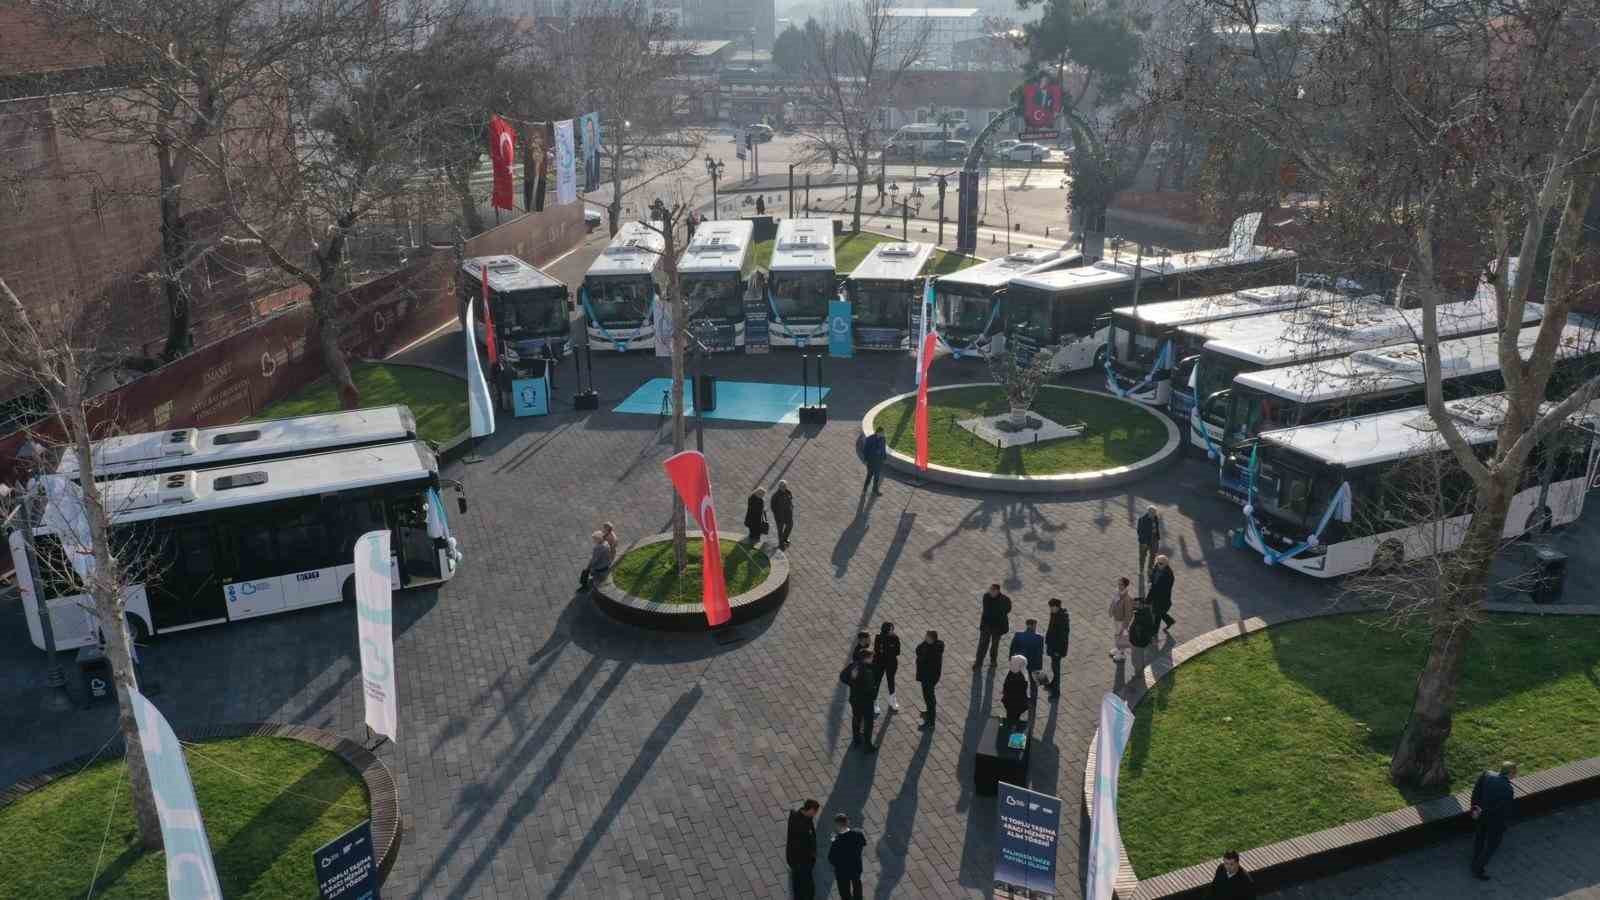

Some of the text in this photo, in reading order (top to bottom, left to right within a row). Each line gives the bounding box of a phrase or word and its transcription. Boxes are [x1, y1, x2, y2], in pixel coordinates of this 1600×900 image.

[1003, 823, 1023, 834] ARACI
[1008, 817, 1030, 829] TOPLU
[328, 868, 349, 885] TOPLU
